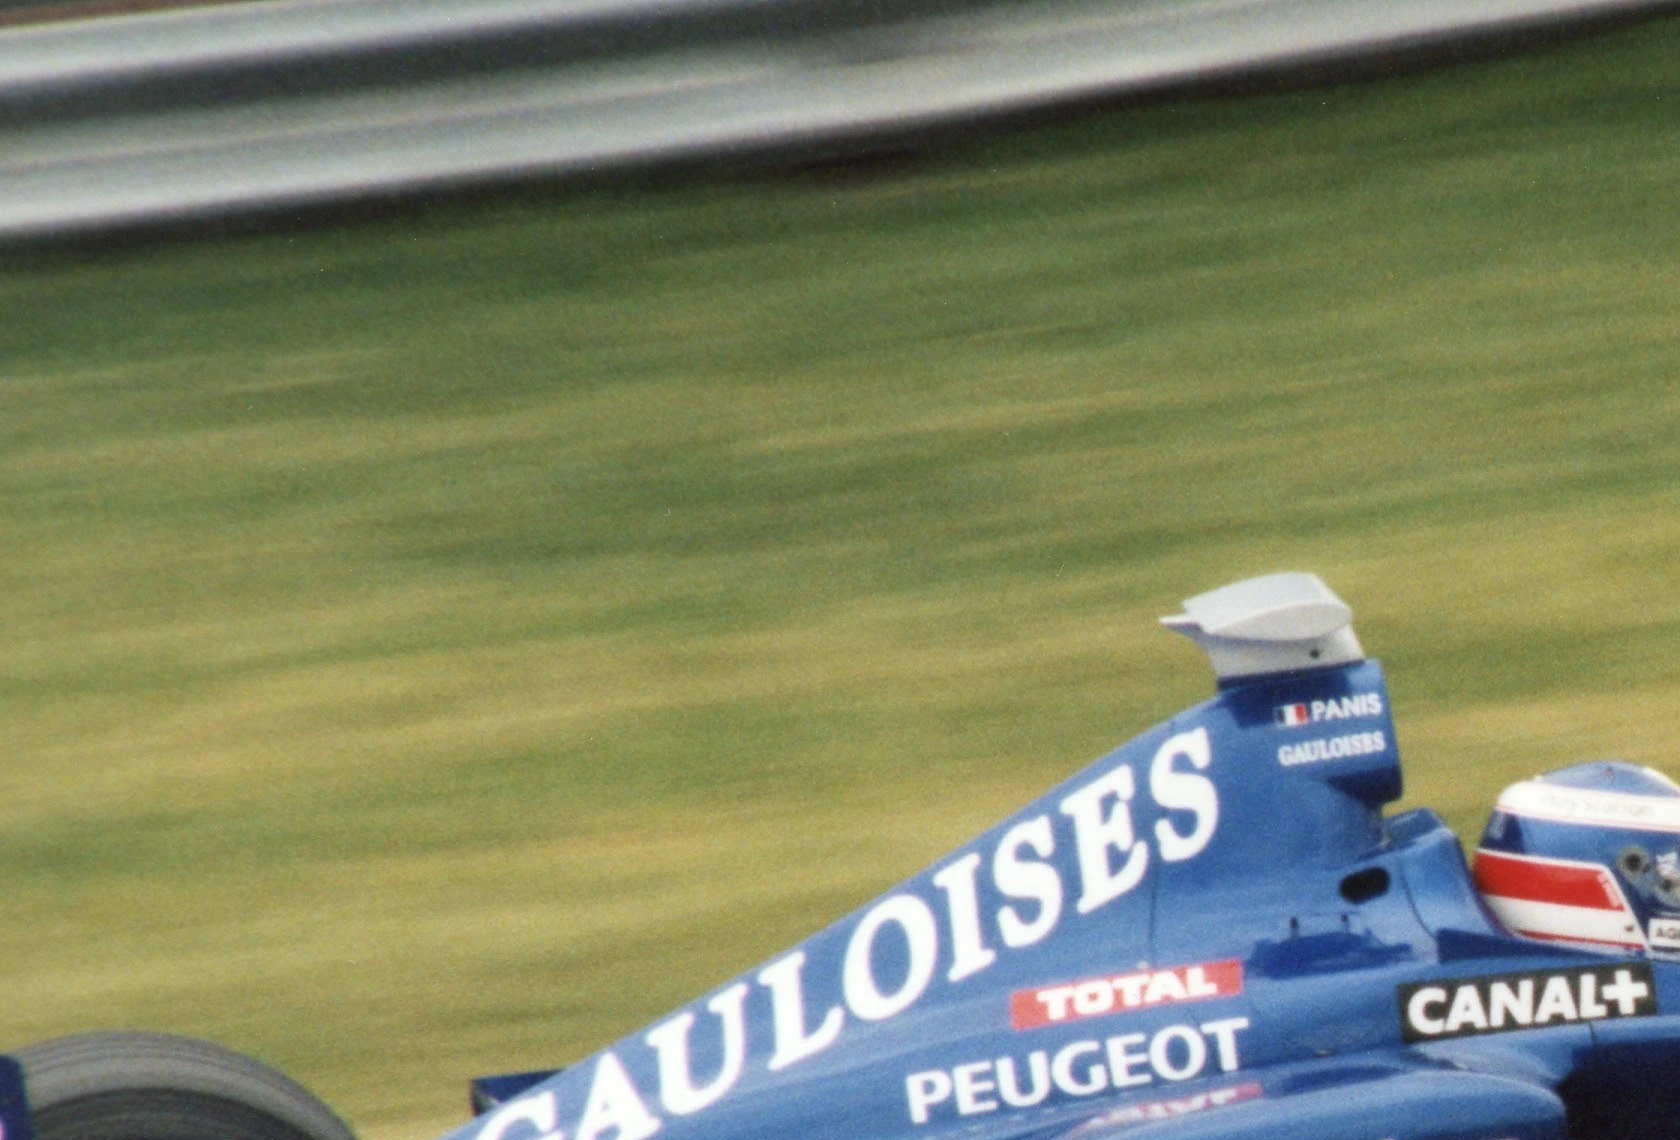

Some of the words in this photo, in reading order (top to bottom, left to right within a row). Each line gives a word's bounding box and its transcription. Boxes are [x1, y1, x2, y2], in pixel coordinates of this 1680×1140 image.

[1311, 692, 1381, 721] PANIS
[1278, 731, 1385, 766] GAULOISES
[1036, 967, 1217, 1020] TOTAL
[1405, 967, 1650, 1036] CANAL+
[905, 1016, 1250, 1124] PEUGEOT
